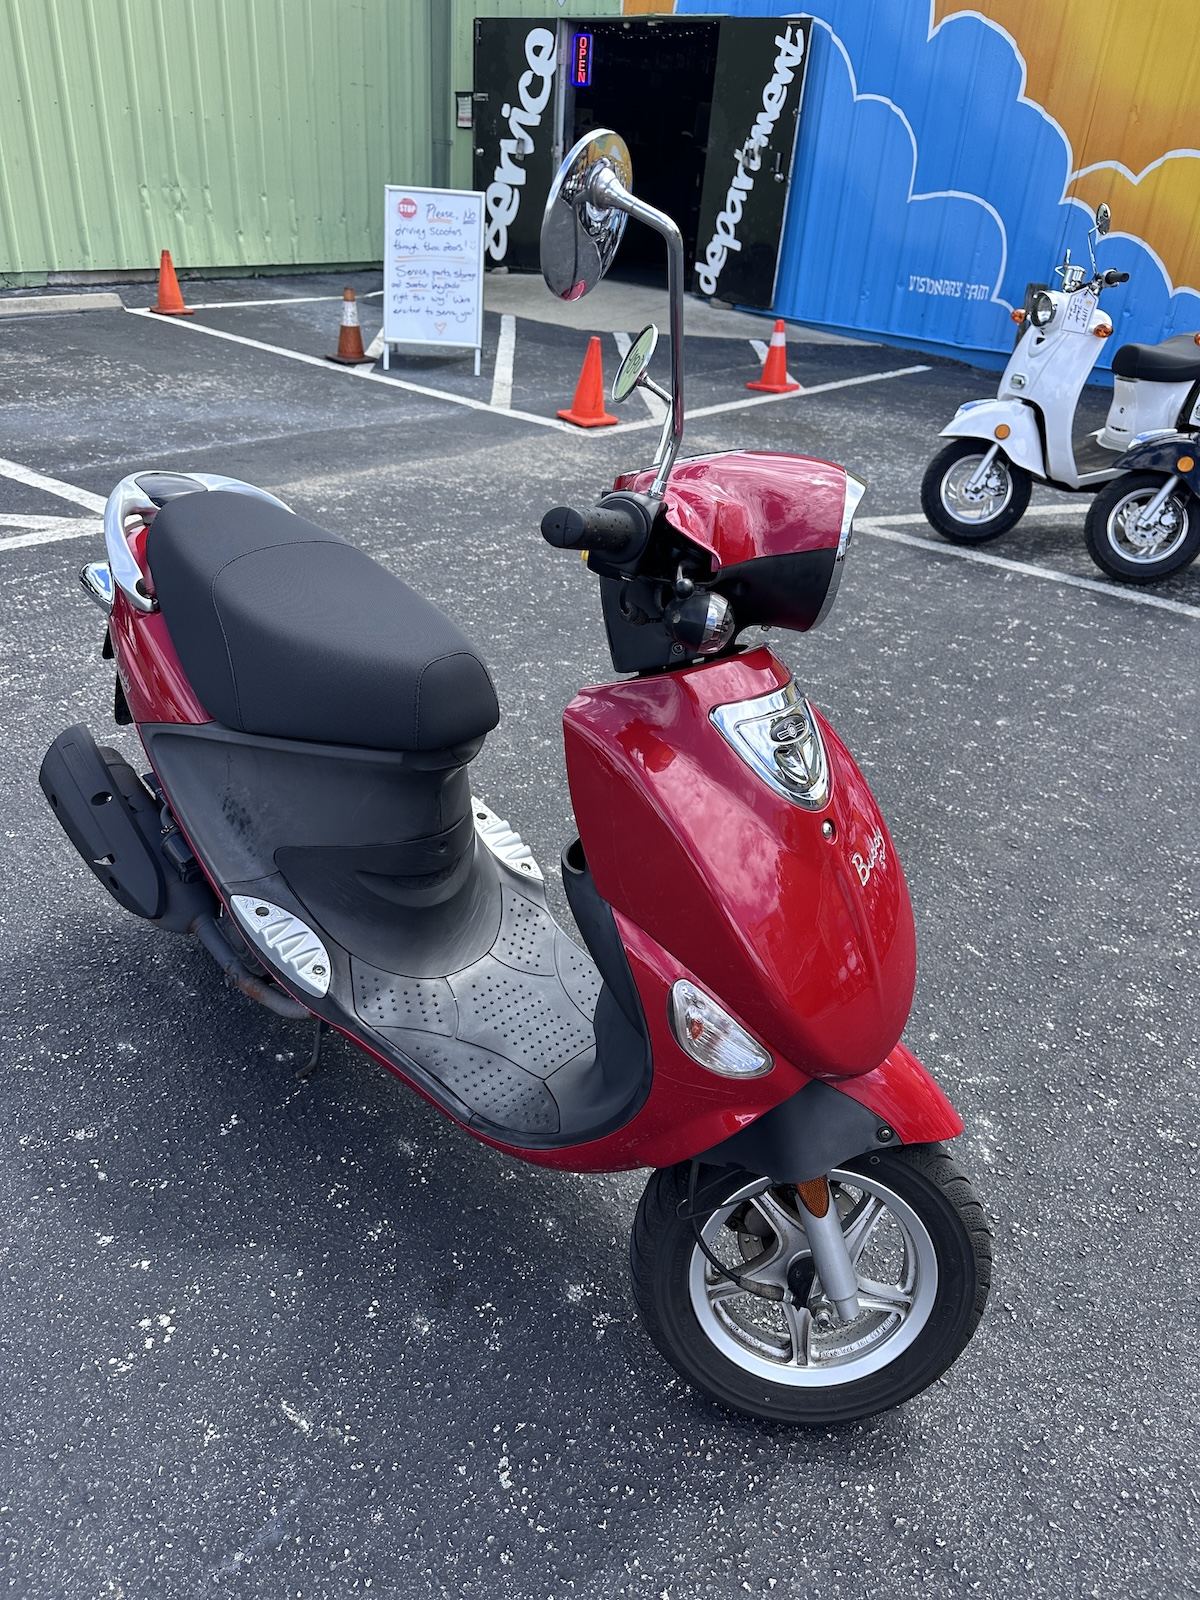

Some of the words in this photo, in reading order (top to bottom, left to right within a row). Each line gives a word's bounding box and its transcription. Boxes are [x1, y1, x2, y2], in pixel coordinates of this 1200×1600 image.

[577, 36, 587, 83] OPEN
[485, 28, 556, 261] service
[695, 25, 803, 295] department
[399, 204, 416, 213] STOP
[463, 208, 477, 221] No
[395, 225, 426, 240] driving
[909, 275, 964, 298] VISIONARY
[425, 306, 434, 316] to
[852, 825, 886, 887] Buddy
